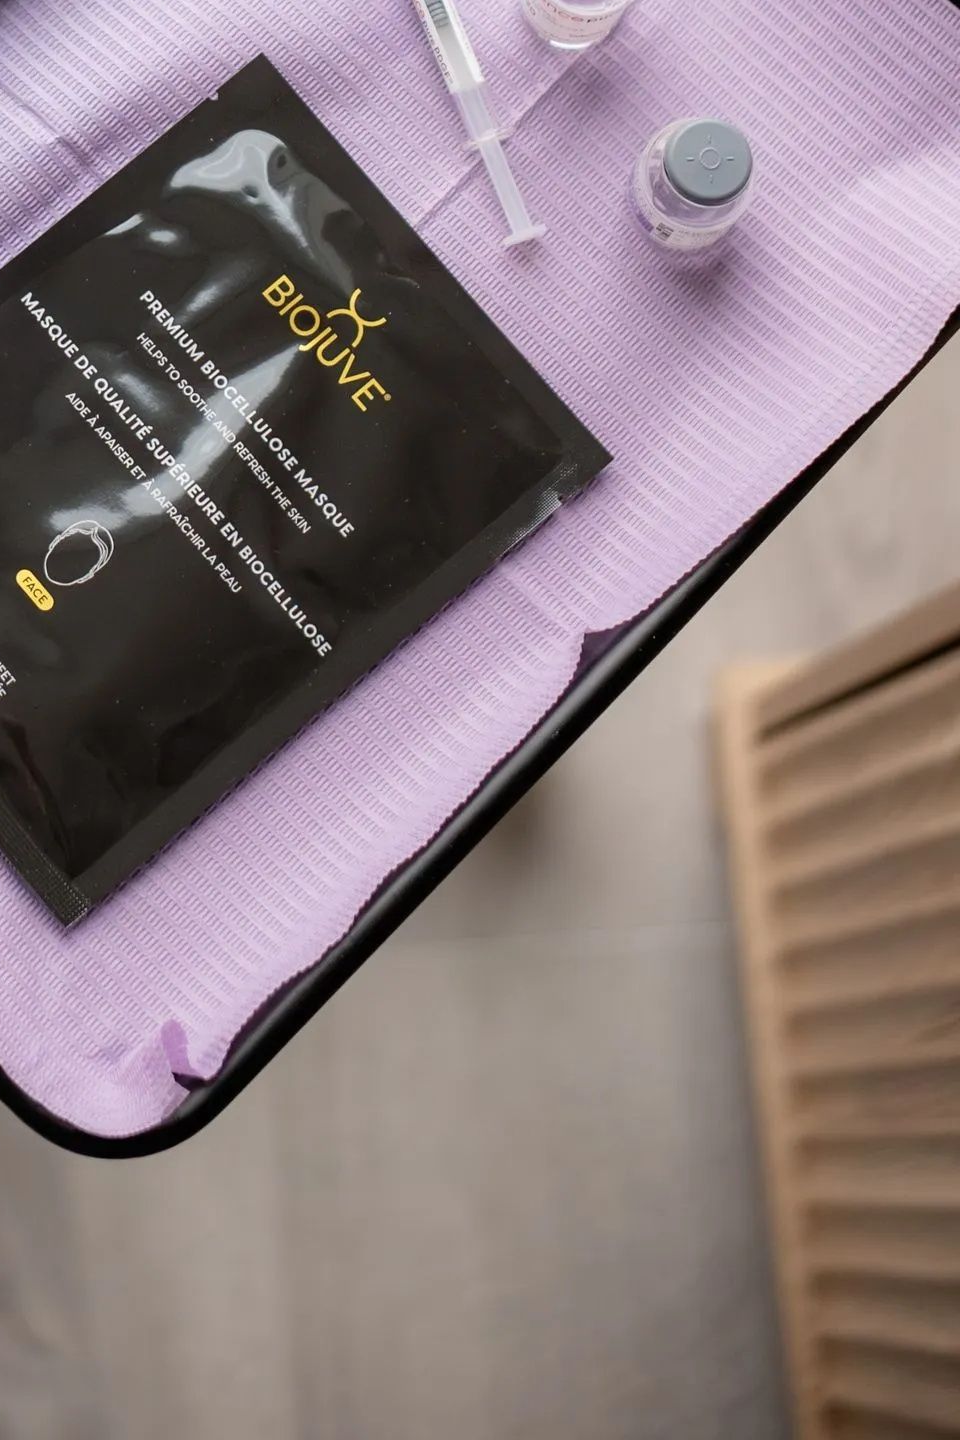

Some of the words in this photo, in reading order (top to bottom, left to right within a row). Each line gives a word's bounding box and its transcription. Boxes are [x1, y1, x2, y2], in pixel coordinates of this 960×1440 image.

[20, 291, 79, 358] MASQUE
[74, 355, 98, 380] DE
[94, 378, 153, 441] QUALITÉ
[146, 438, 225, 525] SUPÉRIEURE
[220, 522, 243, 548] EN
[238, 545, 332, 656] BIOCELLULOSE
[65, 392, 92, 418] AIDE
[86, 414, 99, 428] À
[94, 426, 134, 469] APAISER
[130, 465, 147, 481] ET
[141, 478, 155, 491] À
[150, 487, 206, 550] RAFRAÎCHIR
[201, 547, 218, 566] LA
[214, 563, 242, 593] PEAU
[136, 332, 168, 367] HELPS
[164, 363, 181, 381] TO
[177, 378, 217, 422] SOOTHE
[213, 420, 236, 444] AND
[233, 441, 274, 490] REFRESH
[270, 486, 292, 510] THE
[287, 507, 312, 534] SKIN
[139, 290, 205, 362] PREMIUM
[200, 360, 298, 471] BIOCELLULOSE
[293, 468, 355, 538] MASQUE
[22, 576, 48, 605] FACE
